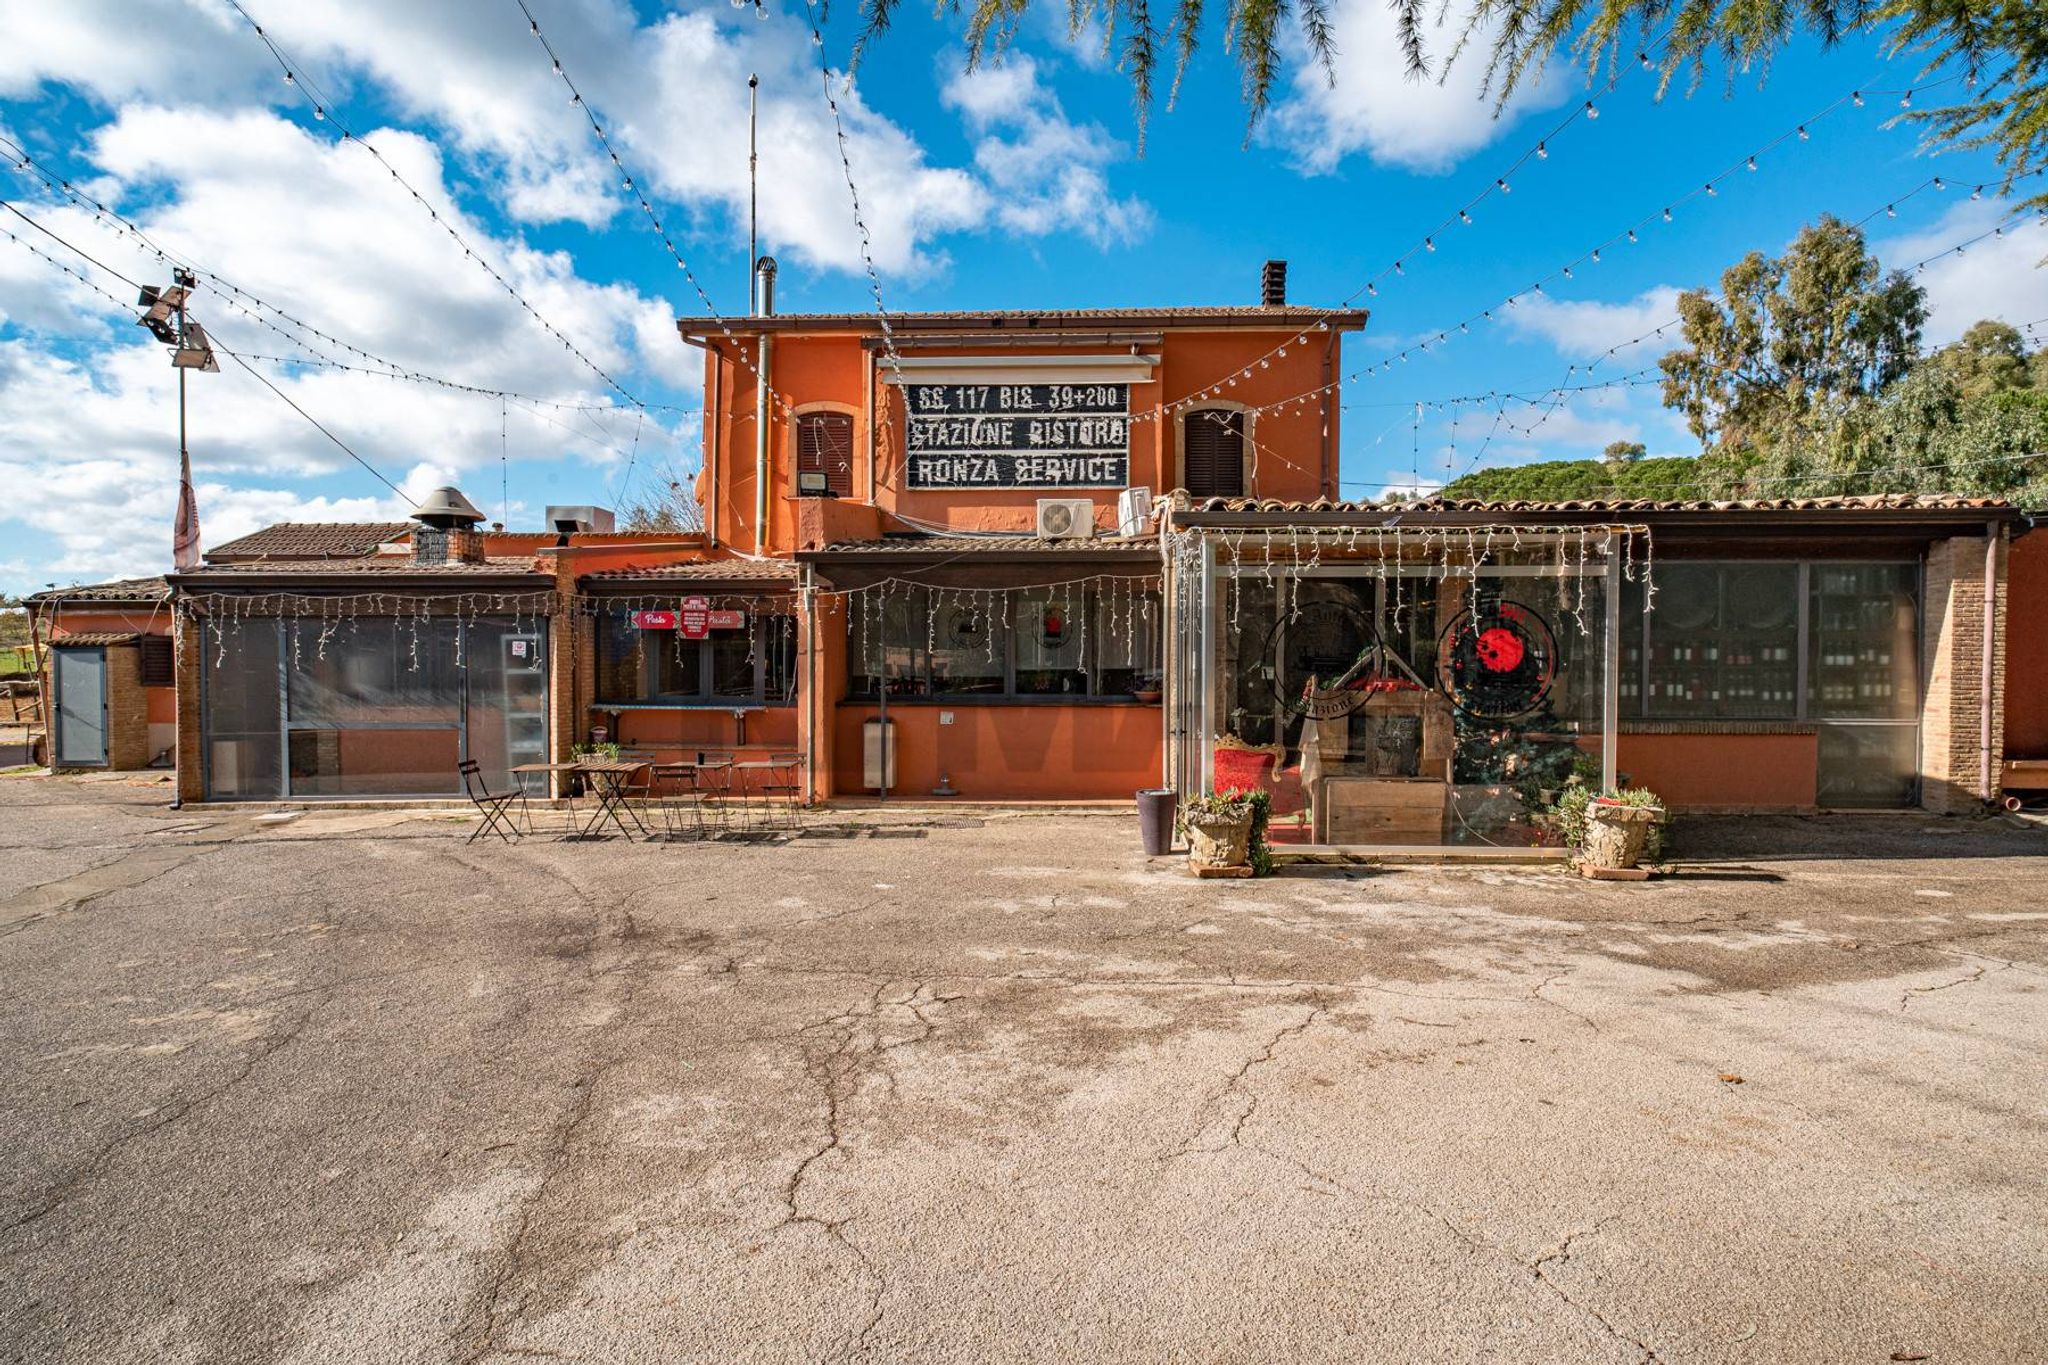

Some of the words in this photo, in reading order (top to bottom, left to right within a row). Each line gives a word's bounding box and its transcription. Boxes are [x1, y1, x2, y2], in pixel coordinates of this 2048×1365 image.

[918, 386, 945, 409] SS
[956, 386, 990, 409] 117
[1000, 386, 1034, 409] BIS
[1048, 386, 1118, 408] 39+200
[911, 421, 1014, 446] STAZIONE
[1028, 420, 1124, 446] RISTORO
[917, 459, 999, 482] RONZA
[1014, 458, 1118, 482] SERVICE
